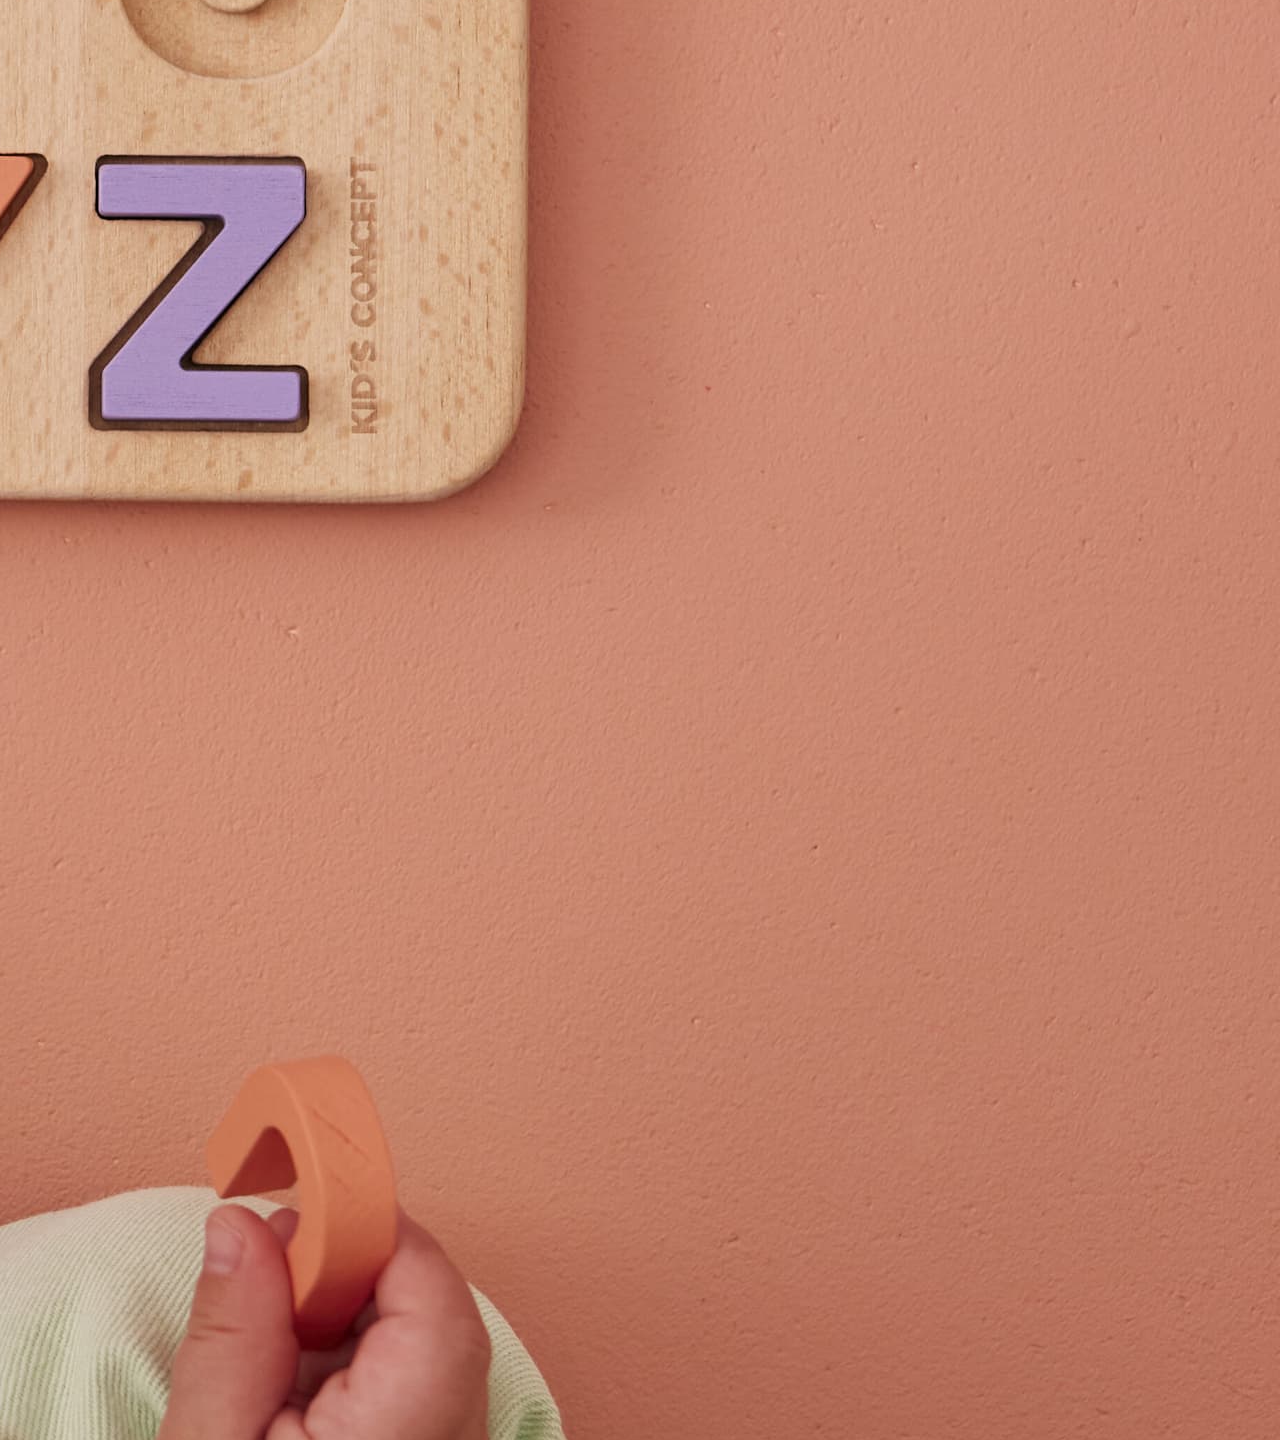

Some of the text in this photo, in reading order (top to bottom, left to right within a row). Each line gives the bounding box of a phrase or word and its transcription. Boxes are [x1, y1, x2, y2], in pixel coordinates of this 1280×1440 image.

[90, 156, 308, 429] Z
[349, 156, 378, 434] KID'S CONCEPT
